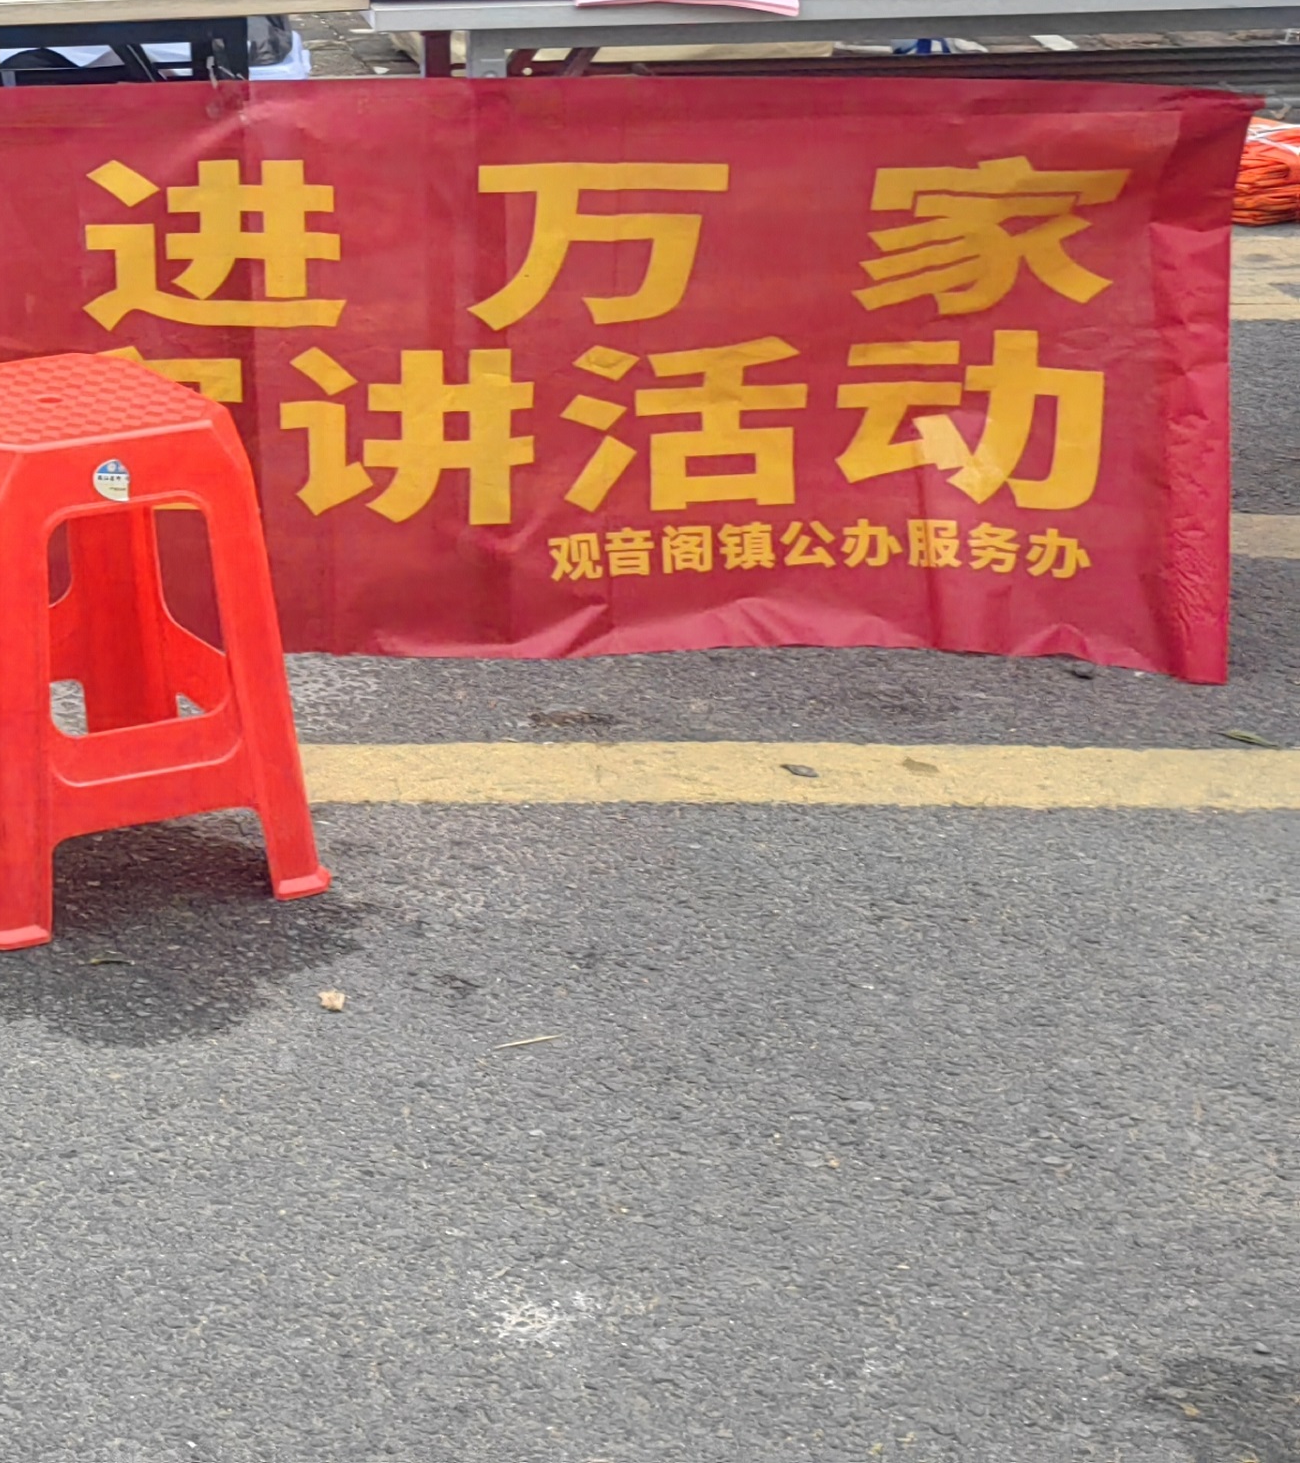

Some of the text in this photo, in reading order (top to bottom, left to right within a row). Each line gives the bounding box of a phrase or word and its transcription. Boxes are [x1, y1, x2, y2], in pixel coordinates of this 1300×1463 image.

[548, 517, 1092, 581] 观音阁镇公办服务办
